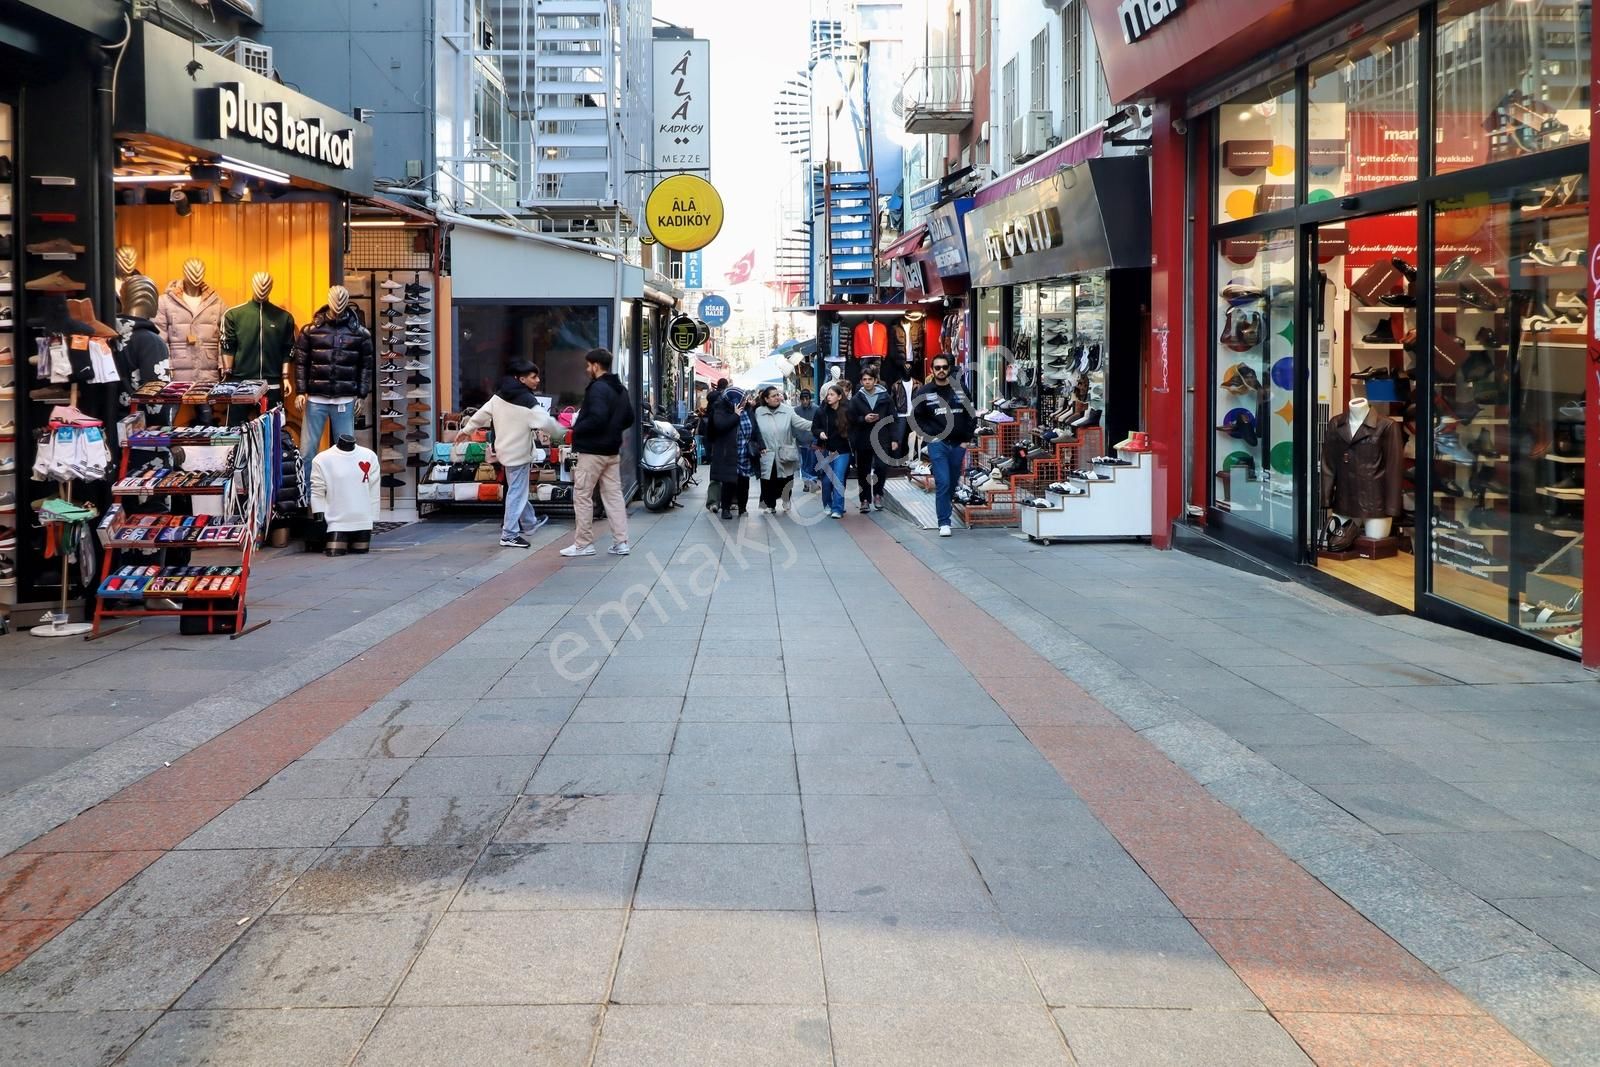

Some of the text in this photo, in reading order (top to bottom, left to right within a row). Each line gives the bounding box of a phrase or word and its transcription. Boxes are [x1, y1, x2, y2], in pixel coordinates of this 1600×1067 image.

[219, 82, 354, 170] plus barkod
[662, 154, 701, 163] MEZZE
[672, 197, 696, 212] ÂLÂ
[658, 212, 711, 227] KADIKÖY
